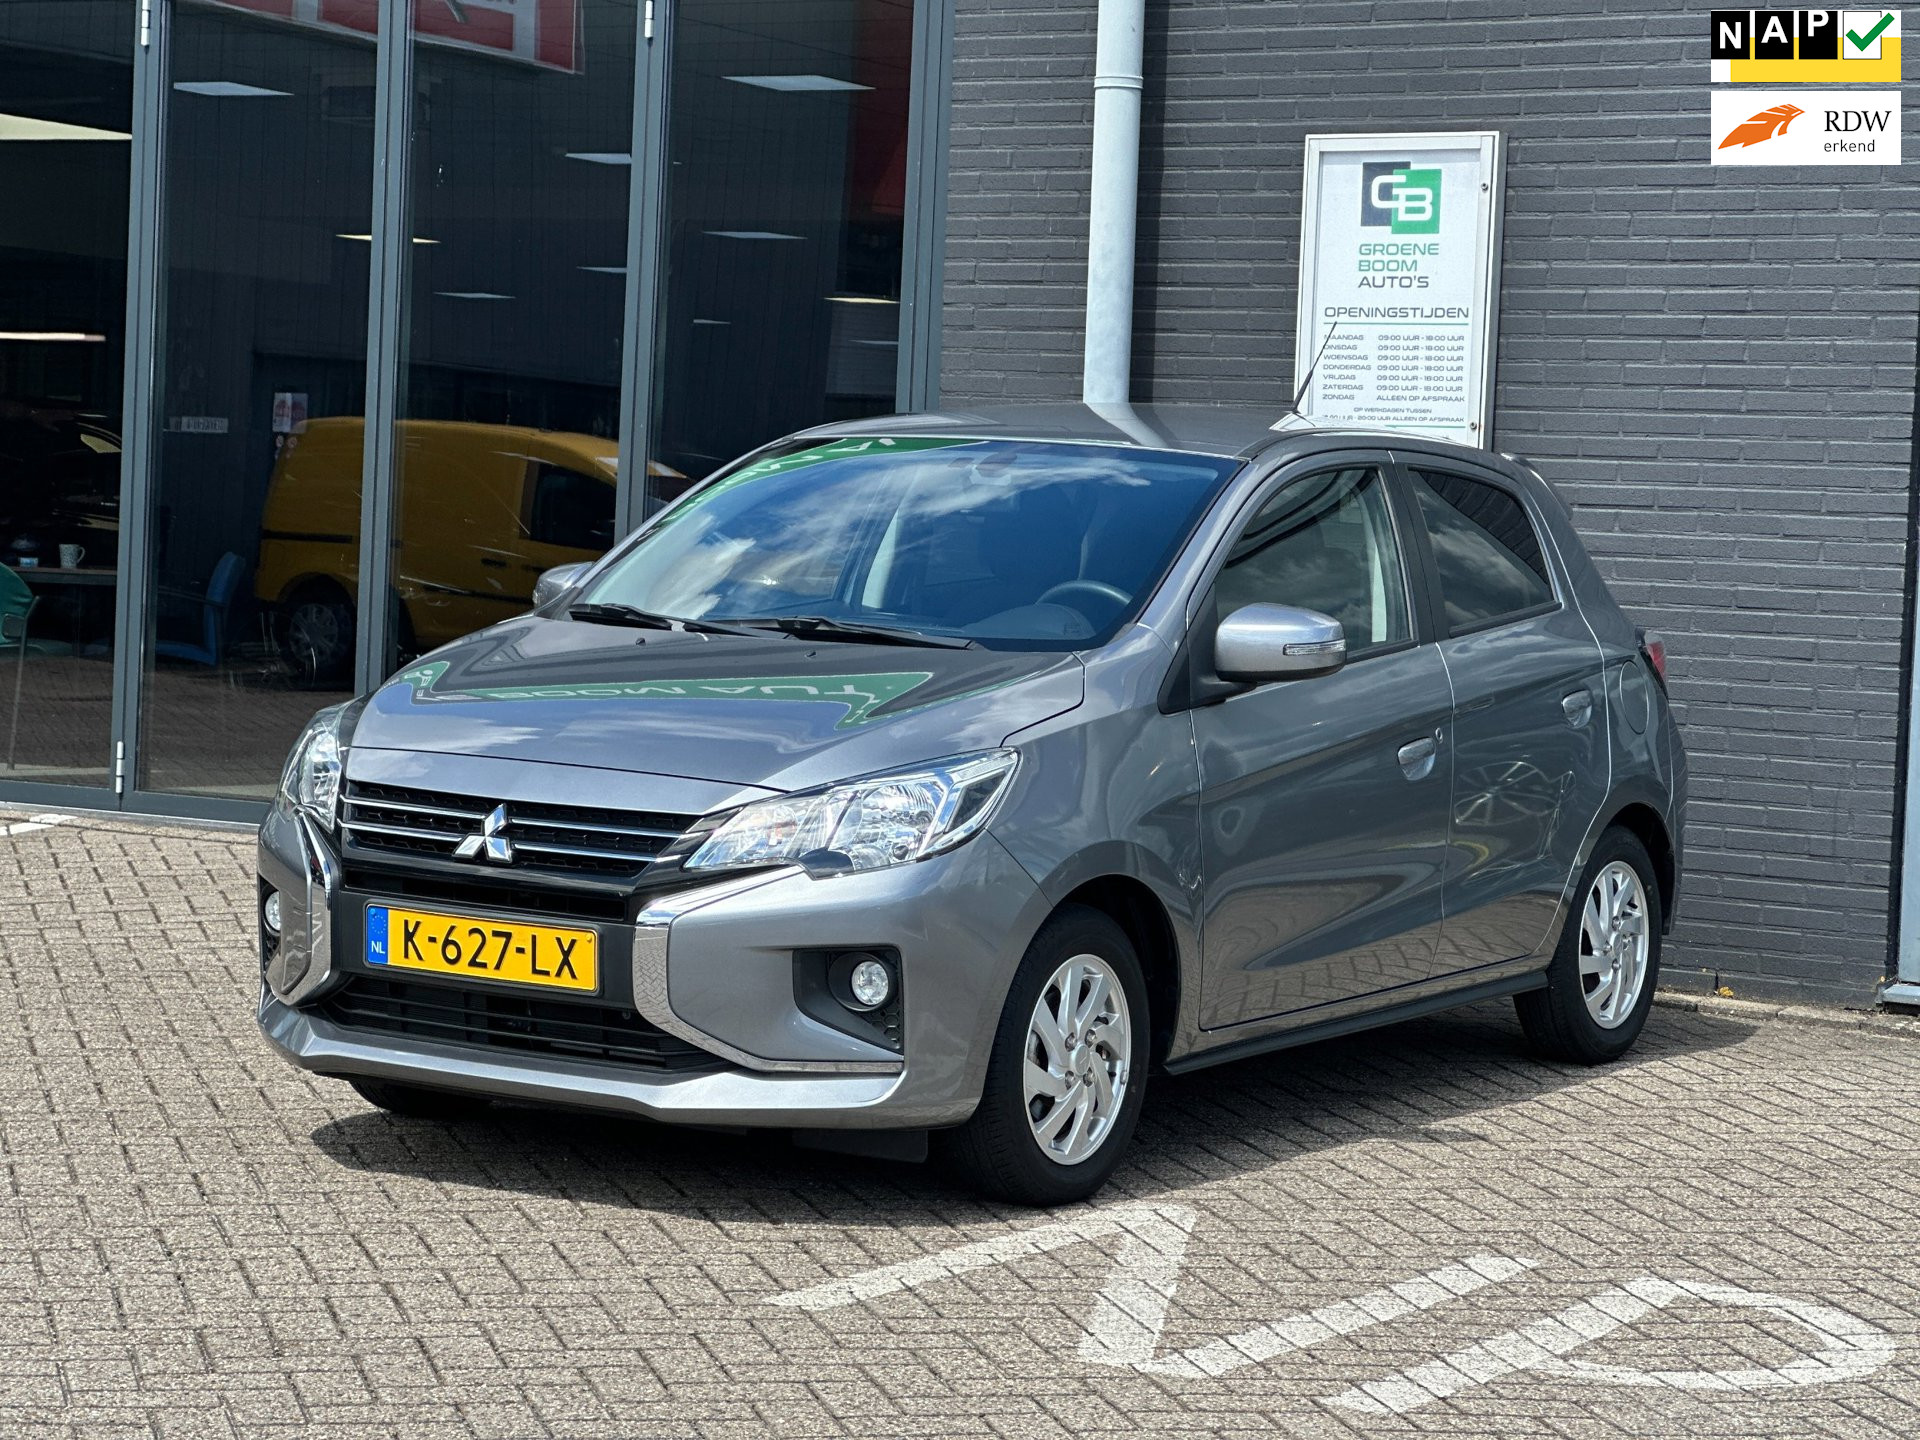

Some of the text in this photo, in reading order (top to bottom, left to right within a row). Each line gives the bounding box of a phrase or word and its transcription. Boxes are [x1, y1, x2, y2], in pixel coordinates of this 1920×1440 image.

[1359, 243, 1440, 256] GROENE
[1358, 260, 1418, 272] BOOM
[1358, 276, 1429, 289] AUTO'S
[1324, 306, 1469, 318] OPENINGSTIJDEN
[371, 919, 579, 980] NL K-627-LX
